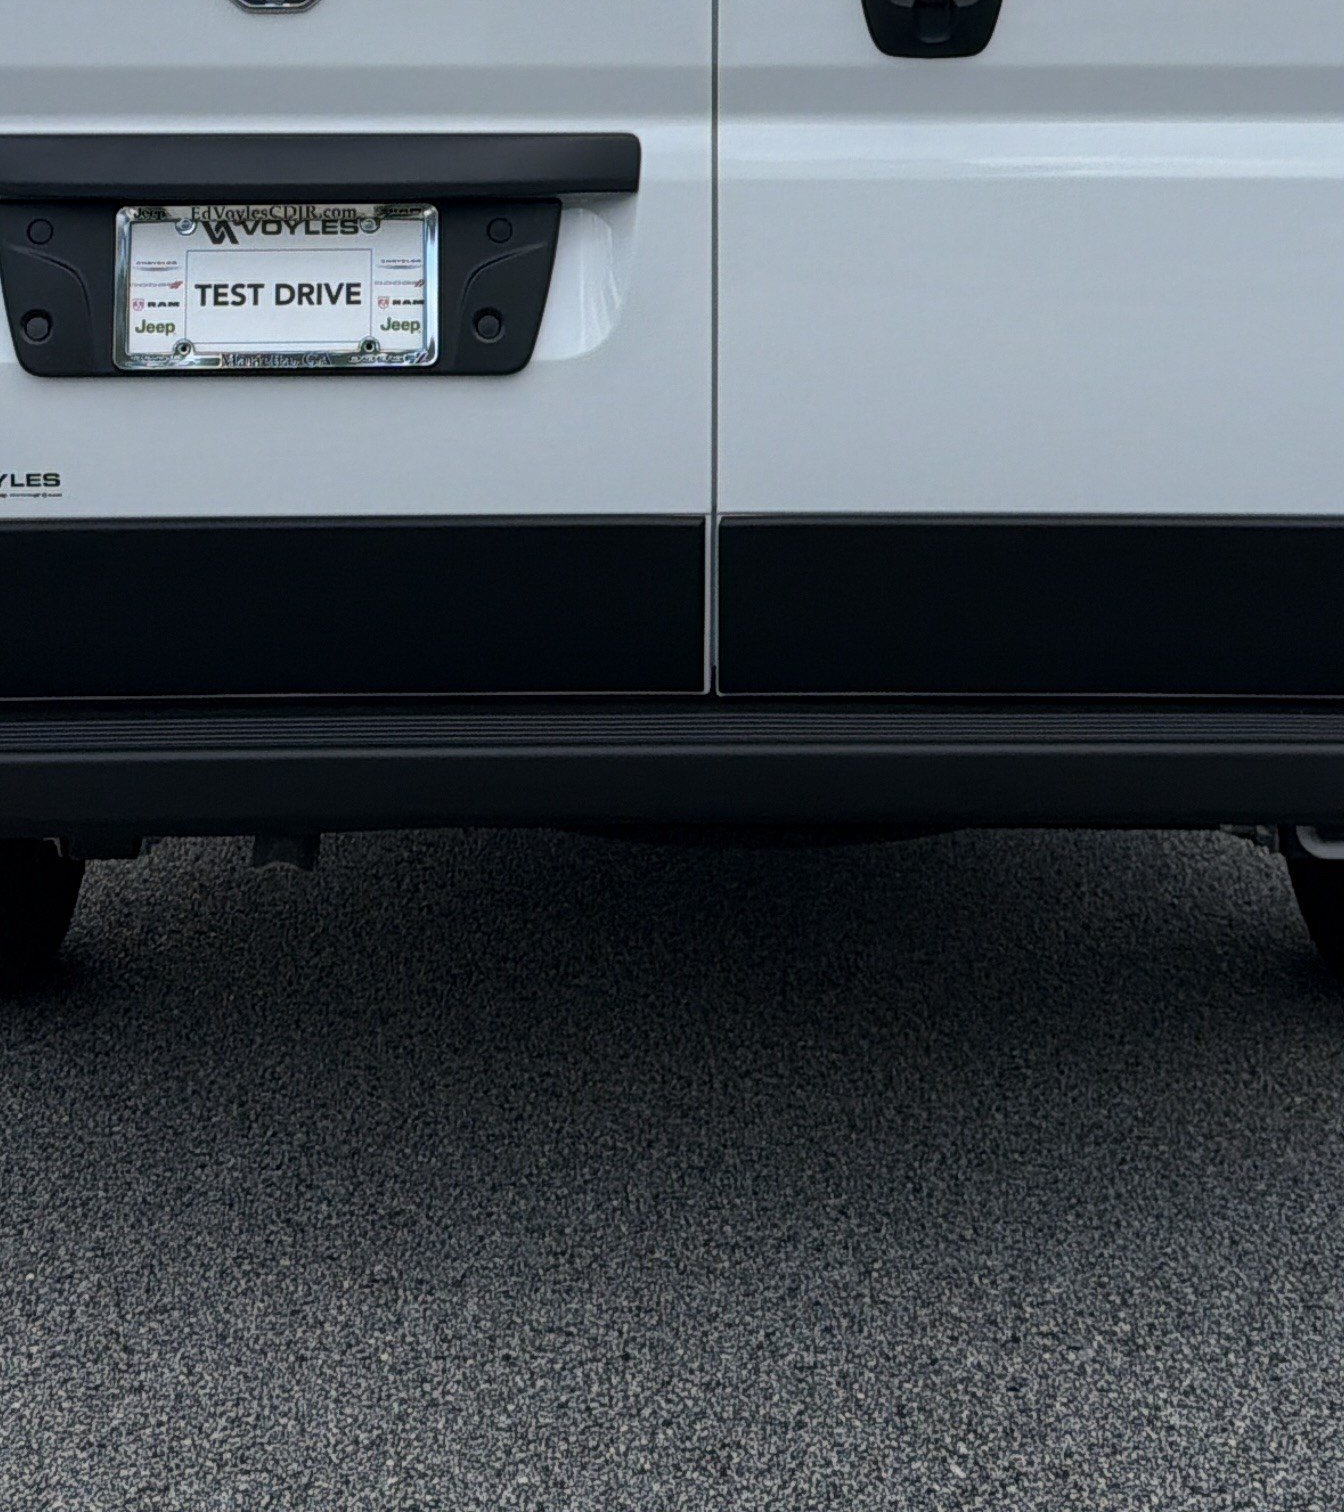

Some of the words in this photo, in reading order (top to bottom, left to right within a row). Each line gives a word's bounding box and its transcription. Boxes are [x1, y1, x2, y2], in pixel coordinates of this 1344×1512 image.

[241, 220, 359, 236] VOYLES
[194, 283, 265, 306] TEST
[274, 282, 362, 306] DRIVE
[135, 319, 176, 336] Jeep
[380, 316, 421, 334] Jeep
